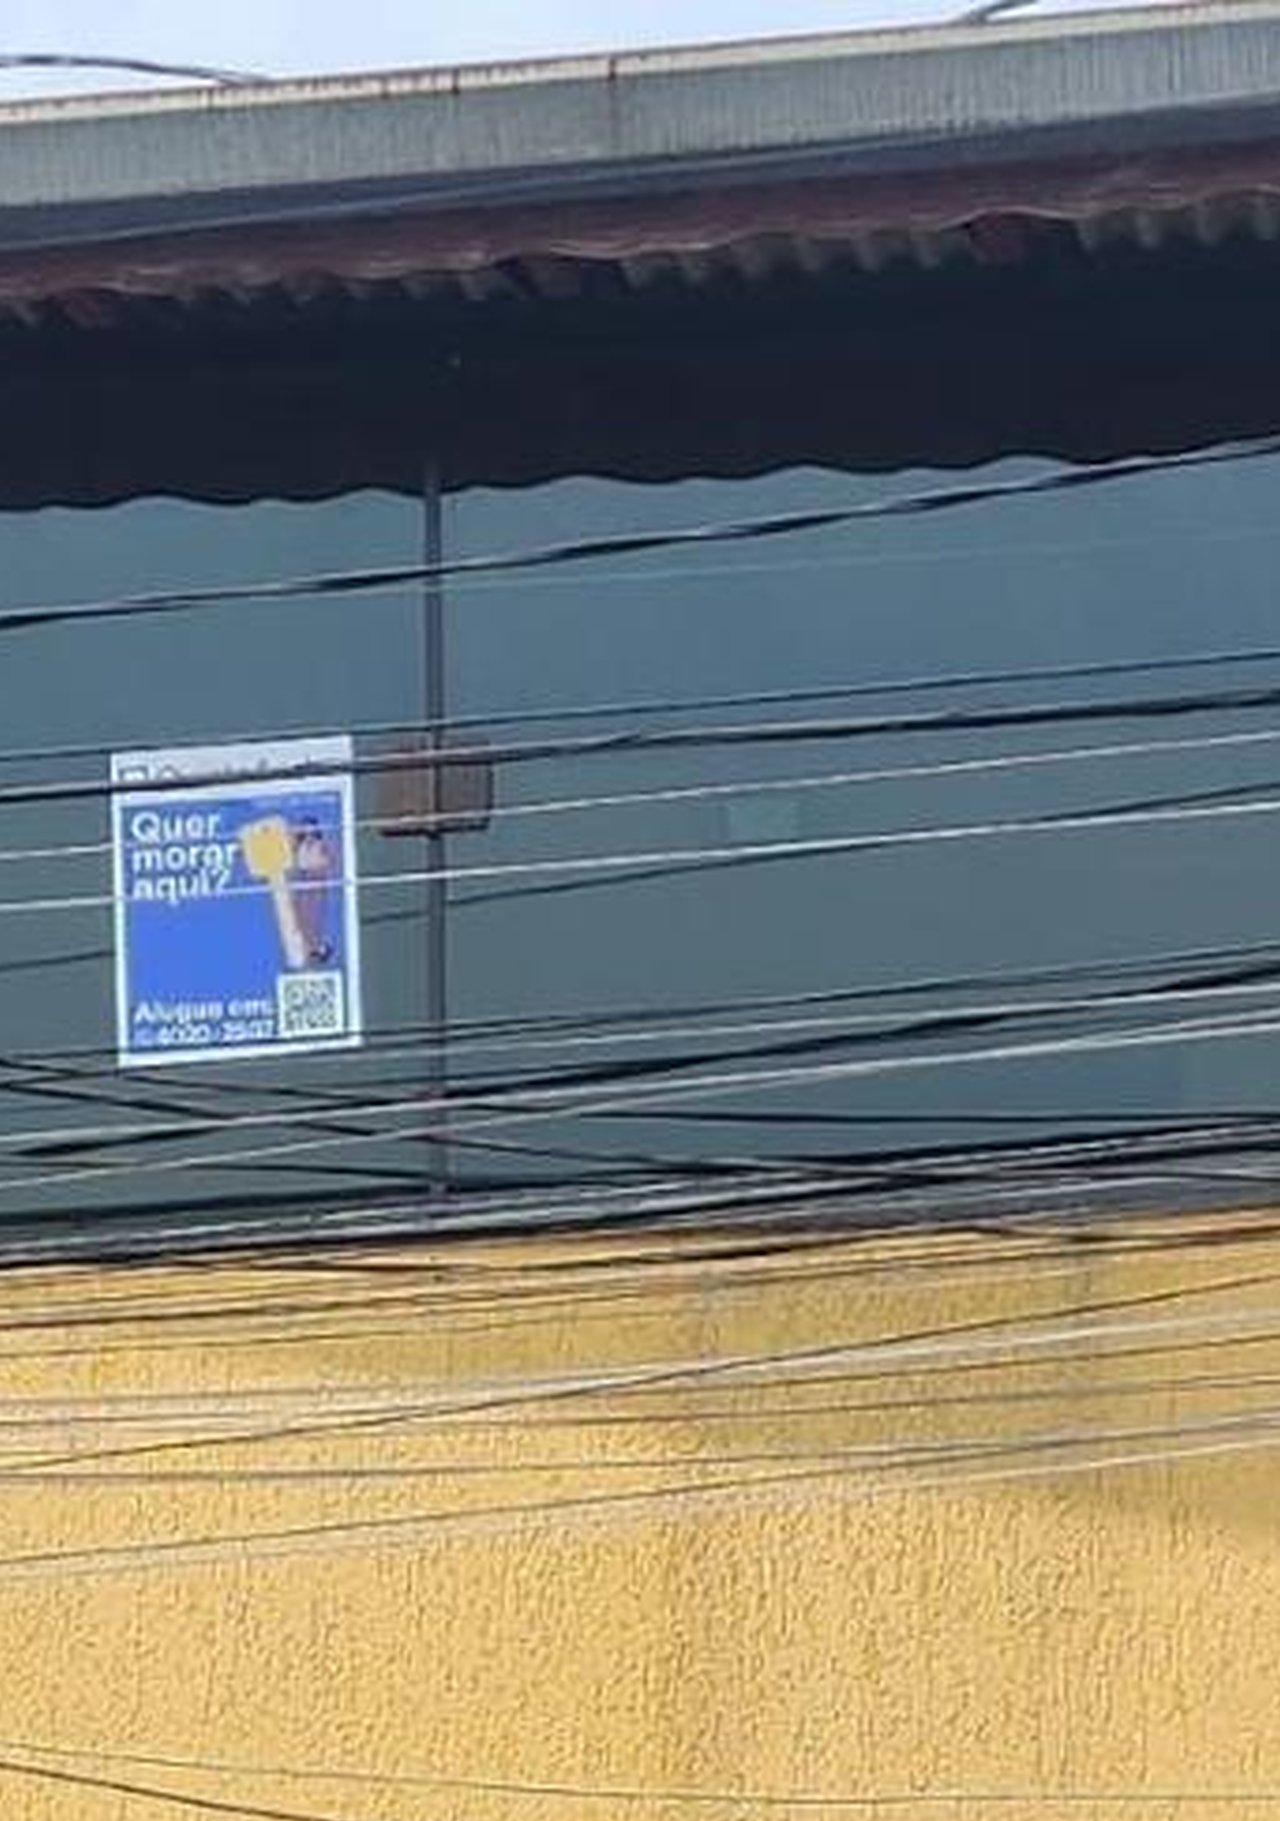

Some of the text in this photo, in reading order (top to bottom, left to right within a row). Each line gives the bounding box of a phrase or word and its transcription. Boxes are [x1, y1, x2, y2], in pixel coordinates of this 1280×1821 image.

[131, 811, 221, 842] Quer
[132, 842, 238, 872] morar
[131, 868, 231, 906] aqui?
